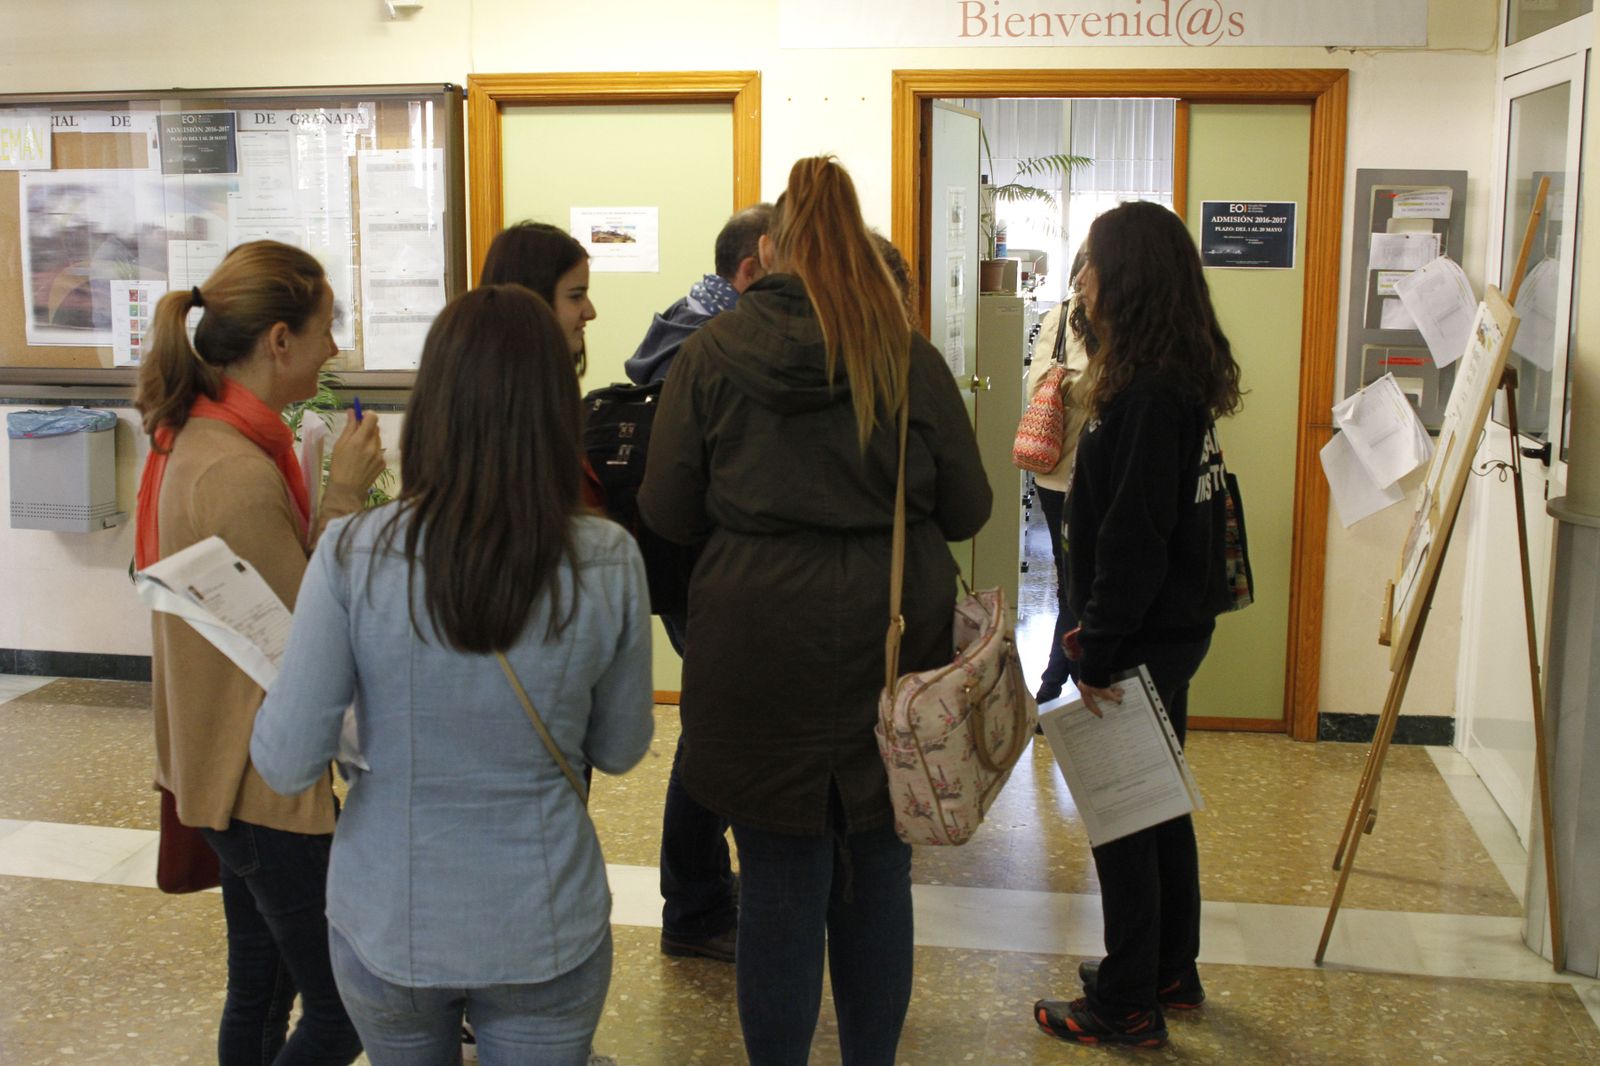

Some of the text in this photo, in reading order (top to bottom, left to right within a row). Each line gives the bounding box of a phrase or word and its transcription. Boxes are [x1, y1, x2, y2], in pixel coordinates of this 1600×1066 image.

[958, 0, 1245, 46] Bienvenid@s
[111, 115, 131, 127] DE
[255, 112, 277, 124] DE
[289, 113, 365, 125] GRANADA
[1229, 203, 1248, 213] EOI
[1211, 215, 1287, 224] ADMISIÓN 2016-2017
